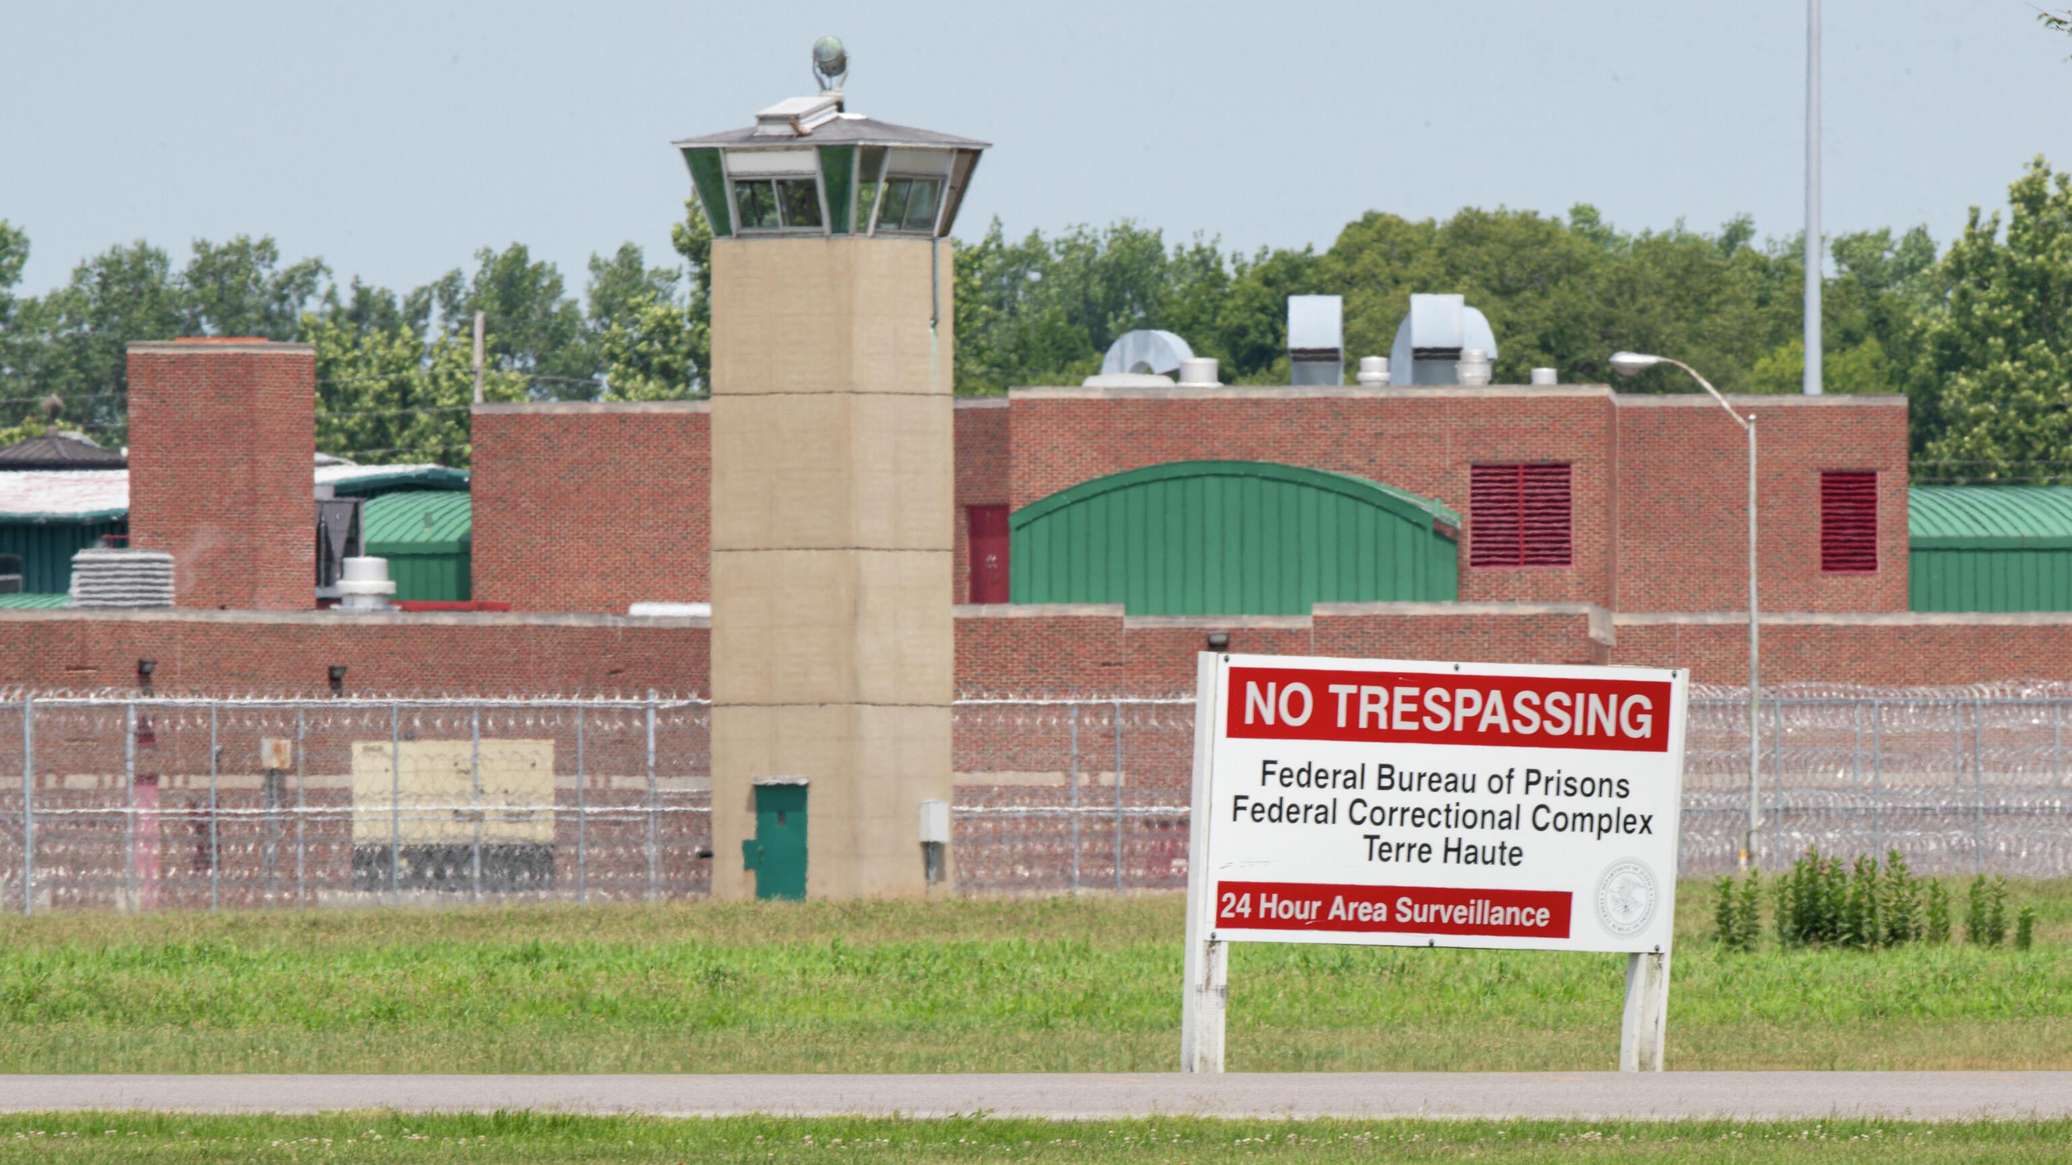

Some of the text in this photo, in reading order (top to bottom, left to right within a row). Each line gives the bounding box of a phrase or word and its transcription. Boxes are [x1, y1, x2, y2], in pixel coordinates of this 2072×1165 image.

[1244, 680, 1653, 739] NO TRESPASSING
[1261, 759, 1630, 799] Federal Bureau of Prisons
[1232, 794, 1653, 841] Federal Correctional Complex
[1363, 834, 1523, 867] Terre Haute
[1220, 892, 1550, 927] 24 Hour Area Surveillance
